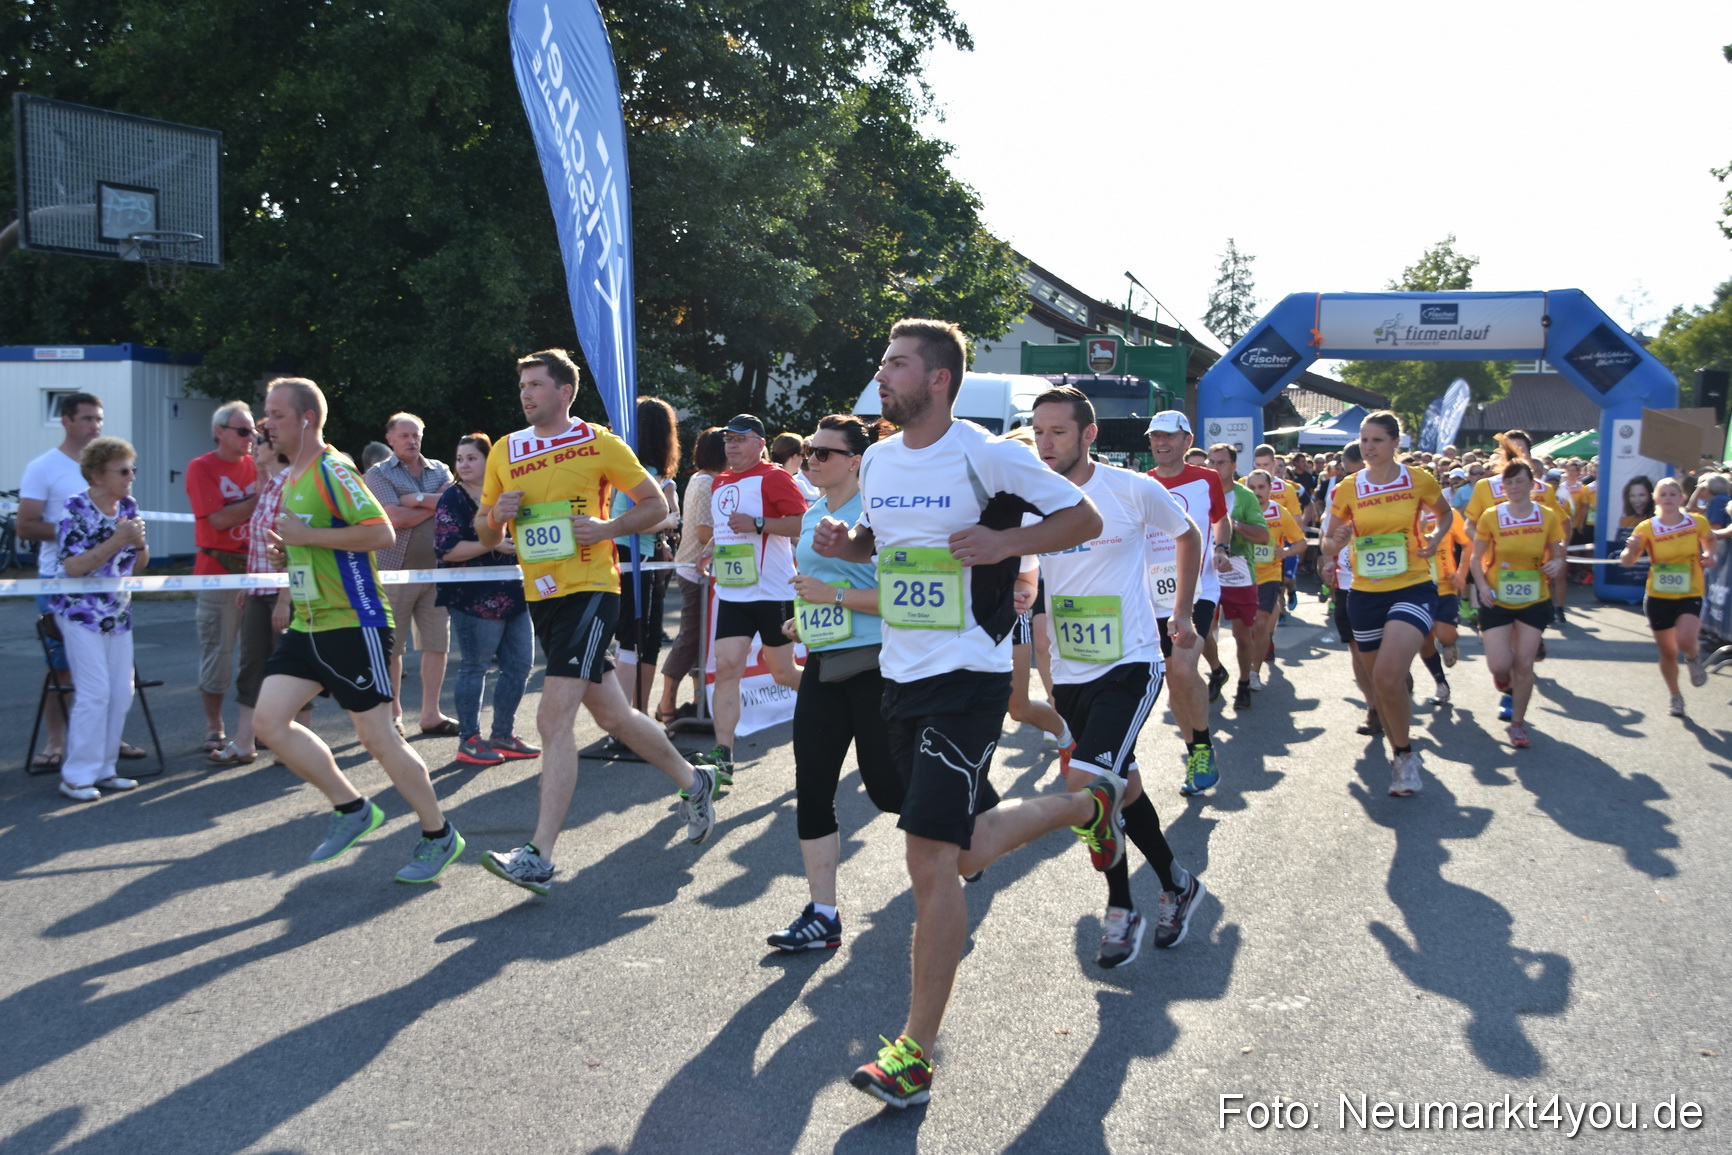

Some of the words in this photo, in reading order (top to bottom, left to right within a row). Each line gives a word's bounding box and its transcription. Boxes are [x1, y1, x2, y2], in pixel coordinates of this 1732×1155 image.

[1405, 325, 1491, 340] firmenlauf
[1248, 354, 1293, 364] Fischer
[510, 458, 548, 480] MAX
[554, 445, 600, 464] BÖGL
[871, 496, 951, 509] DELPHI
[1357, 498, 1382, 509] MAX
[1385, 492, 1414, 503] BÖGL
[525, 525, 561, 547] 880
[1366, 551, 1397, 567] 925
[725, 561, 742, 575] 76
[893, 580, 945, 607] 285
[1156, 577, 1177, 595] 89
[1505, 584, 1532, 596] 926
[800, 605, 844, 630] 1428
[1060, 622, 1111, 645] 1311
